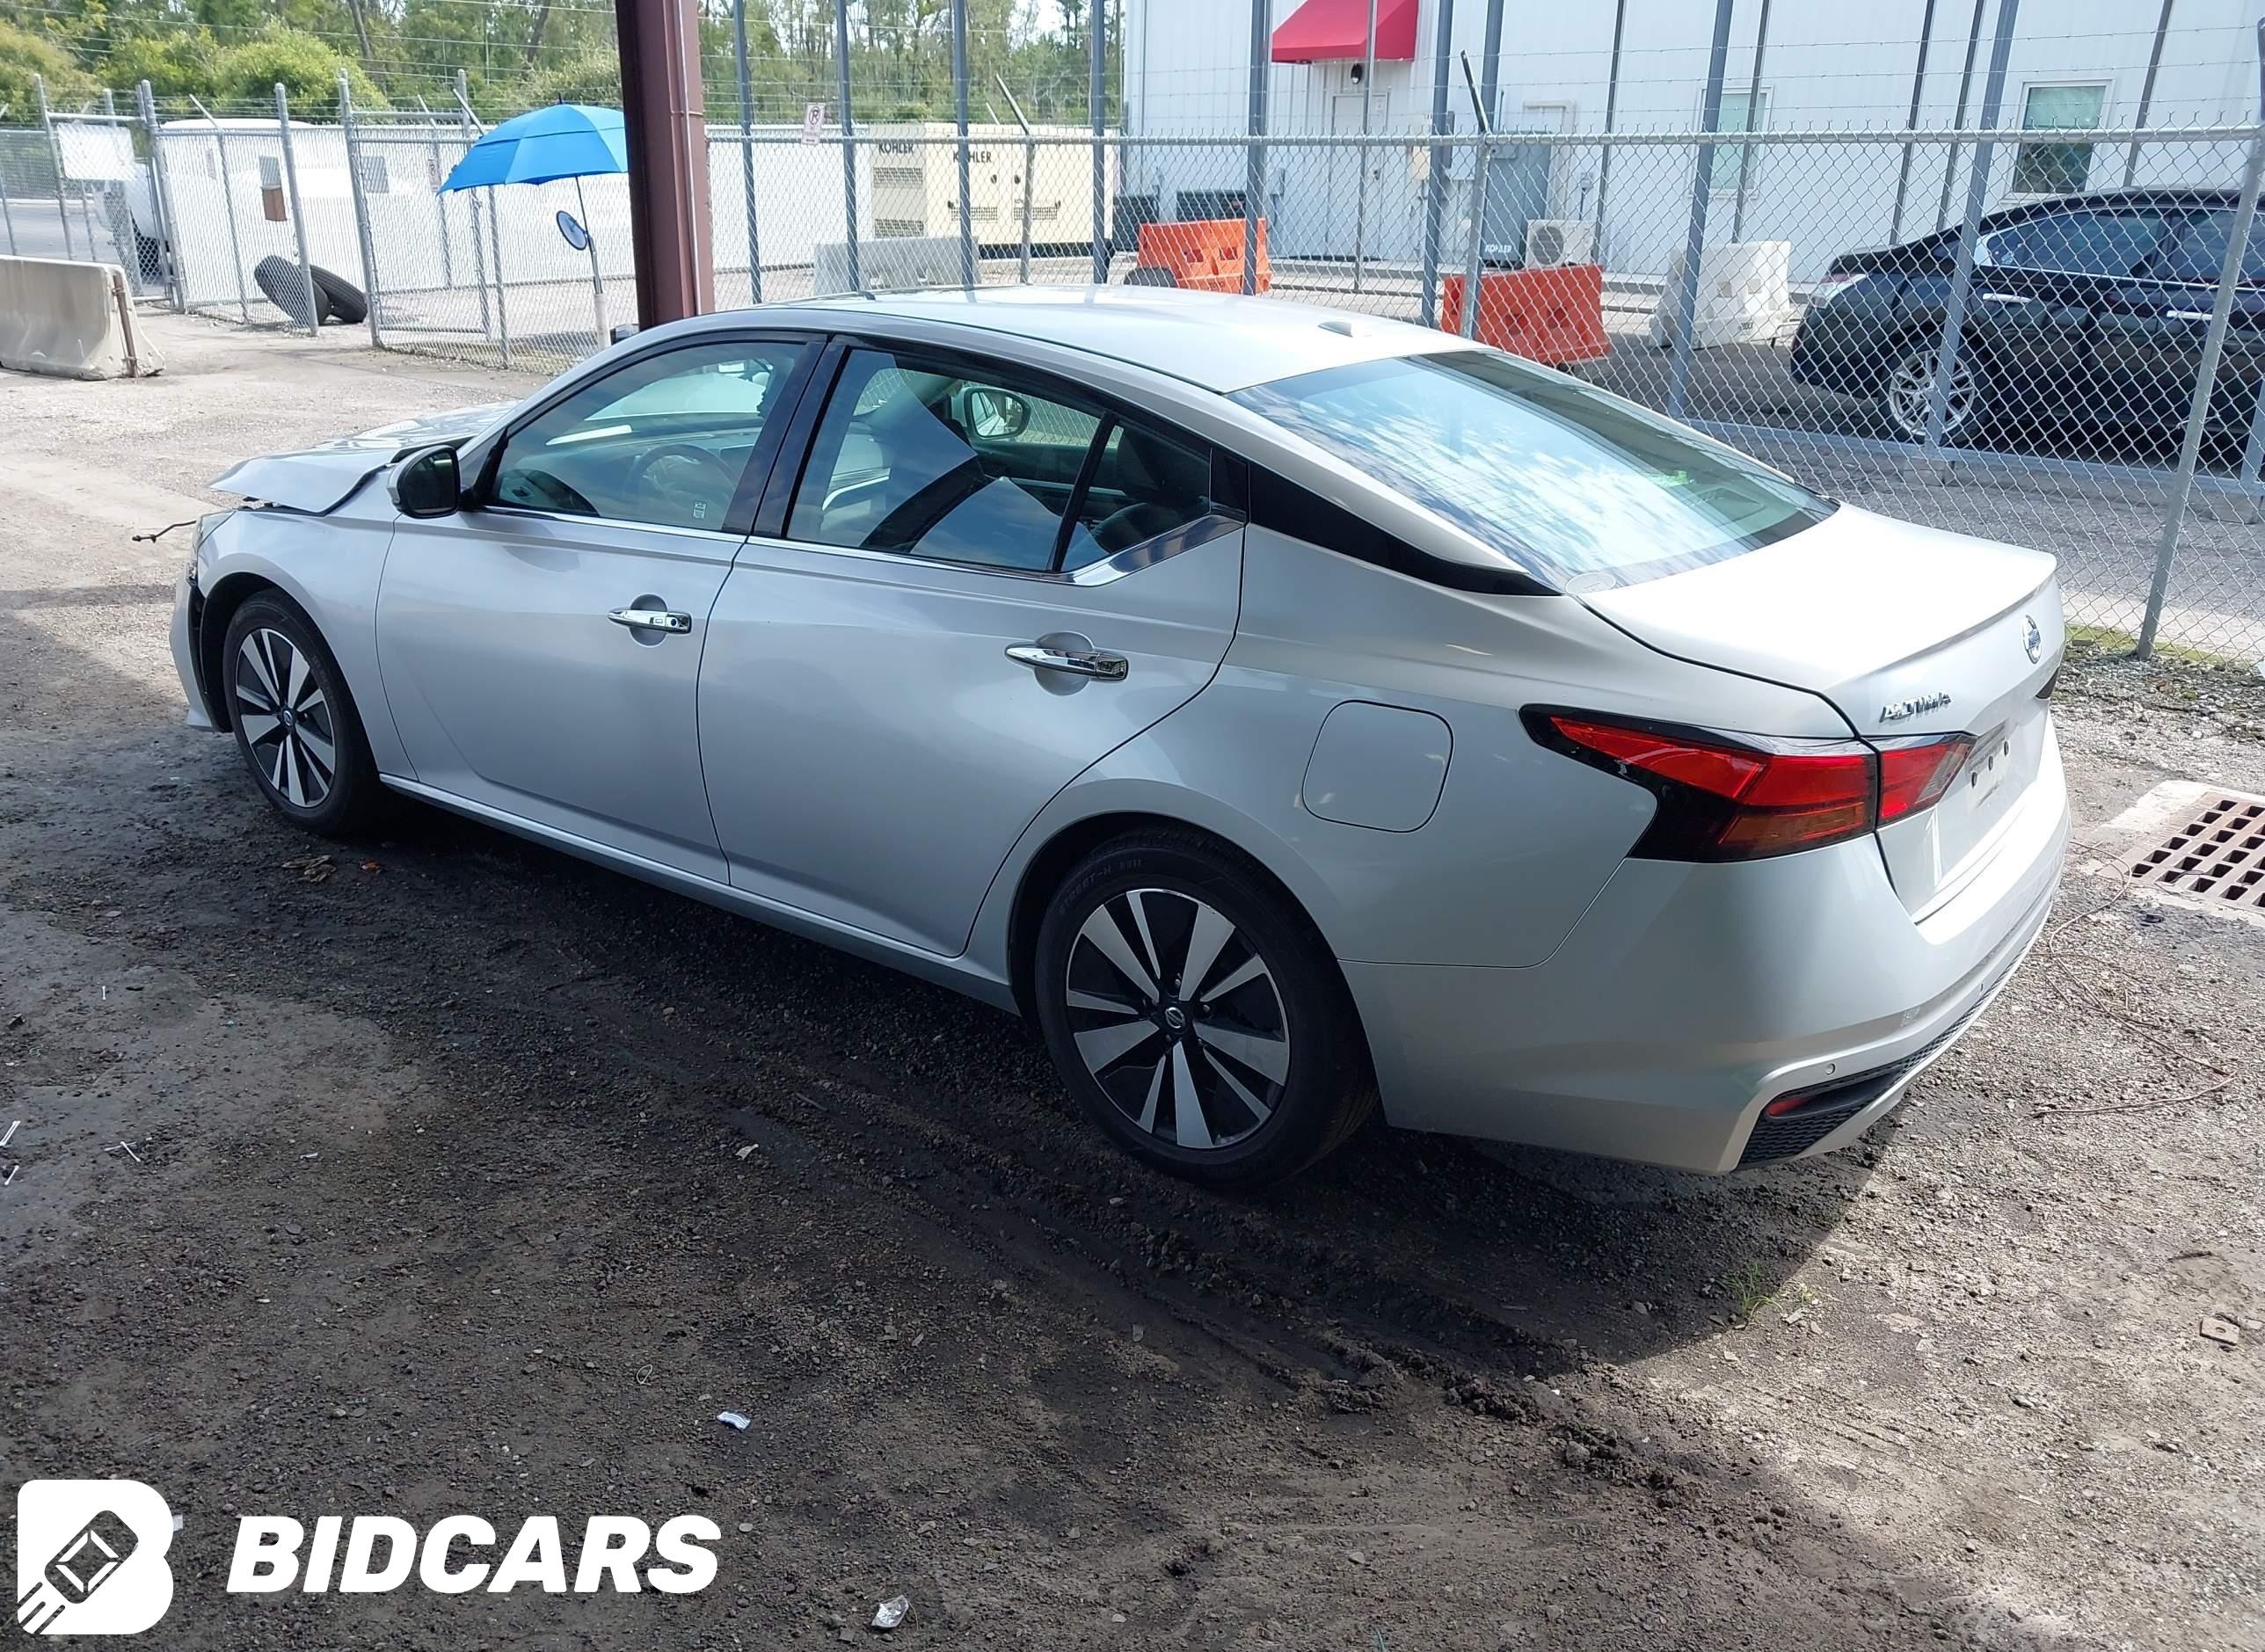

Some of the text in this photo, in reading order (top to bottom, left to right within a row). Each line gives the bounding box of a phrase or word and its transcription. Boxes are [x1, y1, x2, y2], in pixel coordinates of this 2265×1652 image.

[879, 142, 914, 154] KOHLER
[953, 150, 992, 163] KHLER
[1878, 691, 1951, 723] ALTIMA
